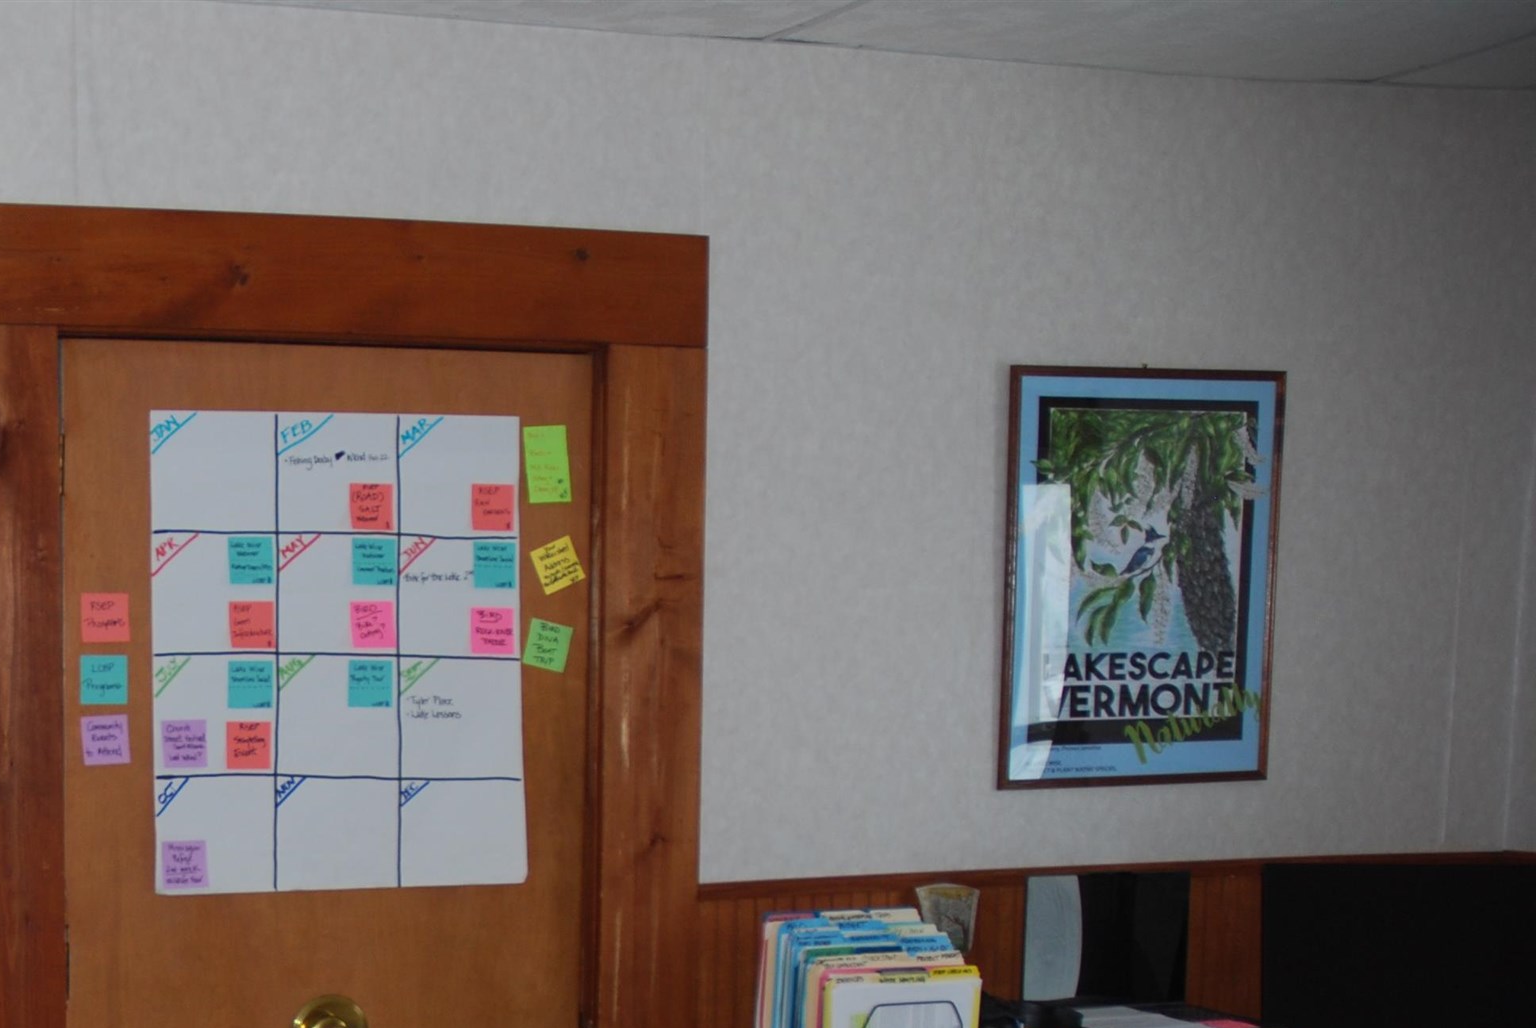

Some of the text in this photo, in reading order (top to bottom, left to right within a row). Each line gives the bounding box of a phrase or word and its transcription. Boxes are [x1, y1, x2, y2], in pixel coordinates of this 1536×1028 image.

[281, 419, 313, 444] FEB
[400, 417, 430, 444] MAR
[155, 537, 179, 561] APR
[281, 535, 306, 560] MAY
[403, 537, 427, 558] JUN
[278, 658, 303, 681] AUG
[1044, 650, 1235, 682] AKESCAPE
[1124, 682, 1264, 765] Naturally
